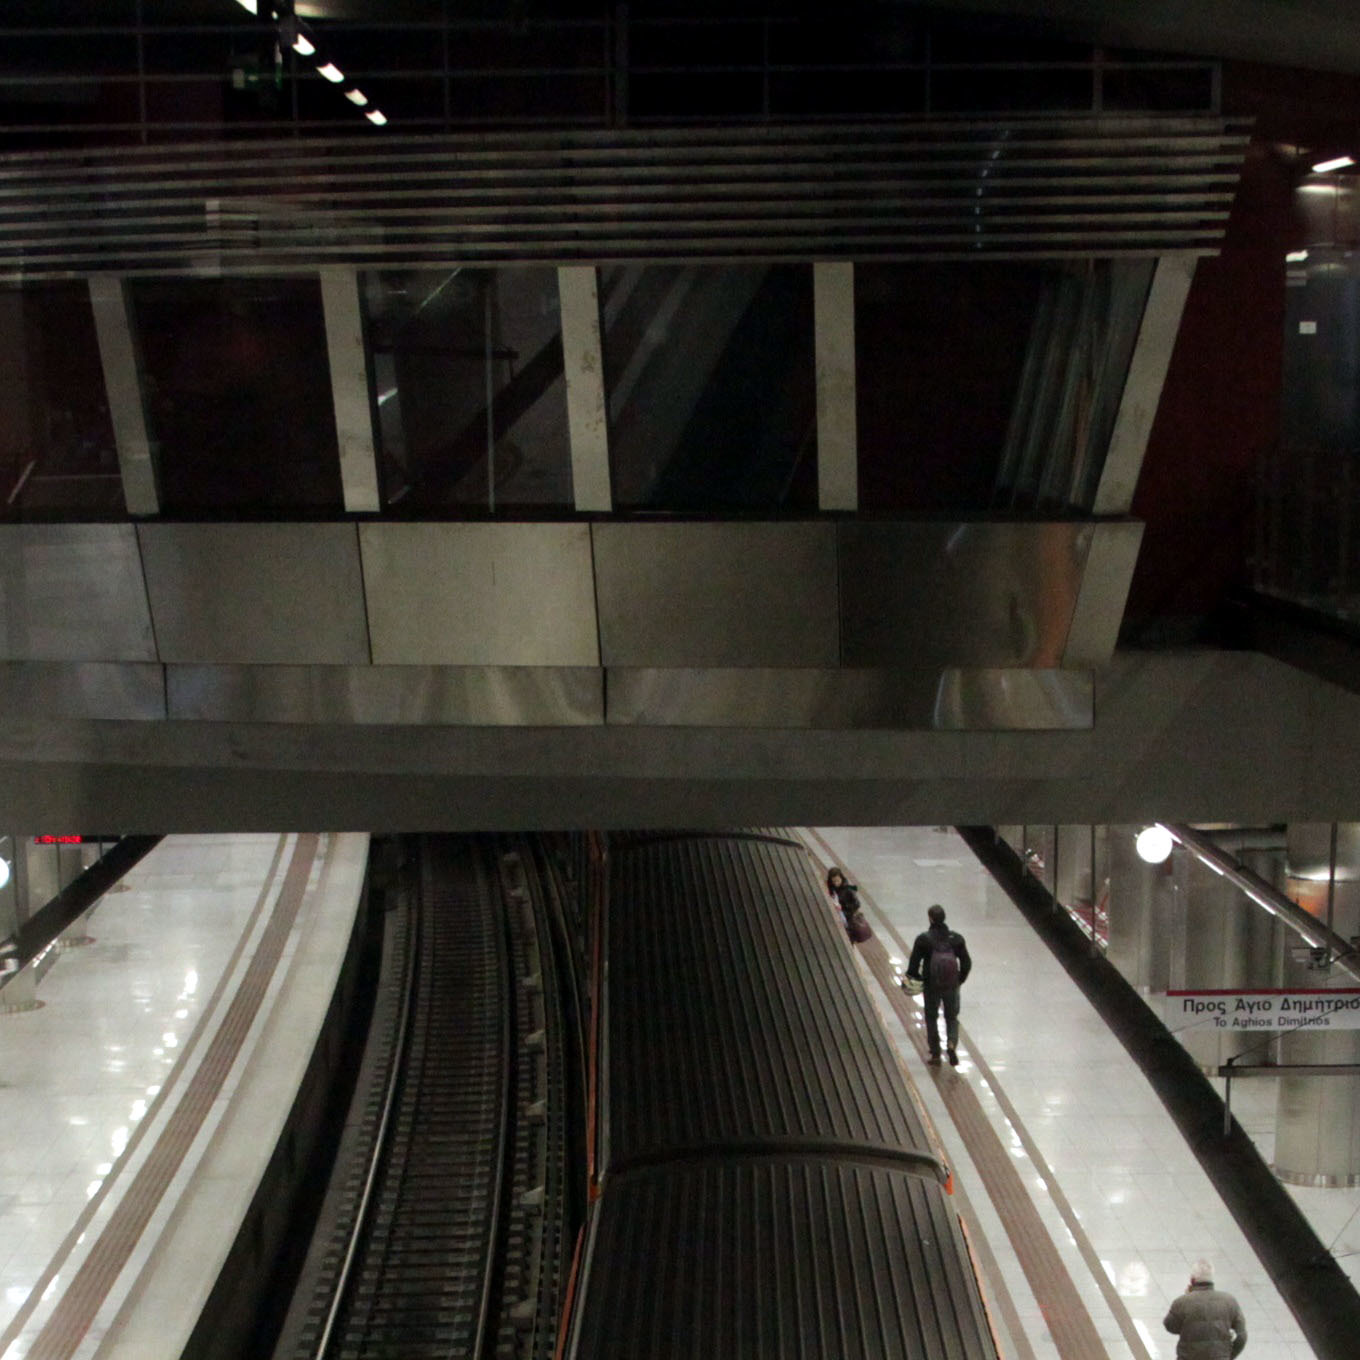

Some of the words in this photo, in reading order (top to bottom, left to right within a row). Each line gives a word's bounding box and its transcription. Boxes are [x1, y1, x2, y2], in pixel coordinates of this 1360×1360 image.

[1183, 999, 1226, 1015] Προς
[1235, 998, 1272, 1015] Άγιο
[1213, 1016, 1227, 1028] To
[1232, 1016, 1272, 1029] Aghios
